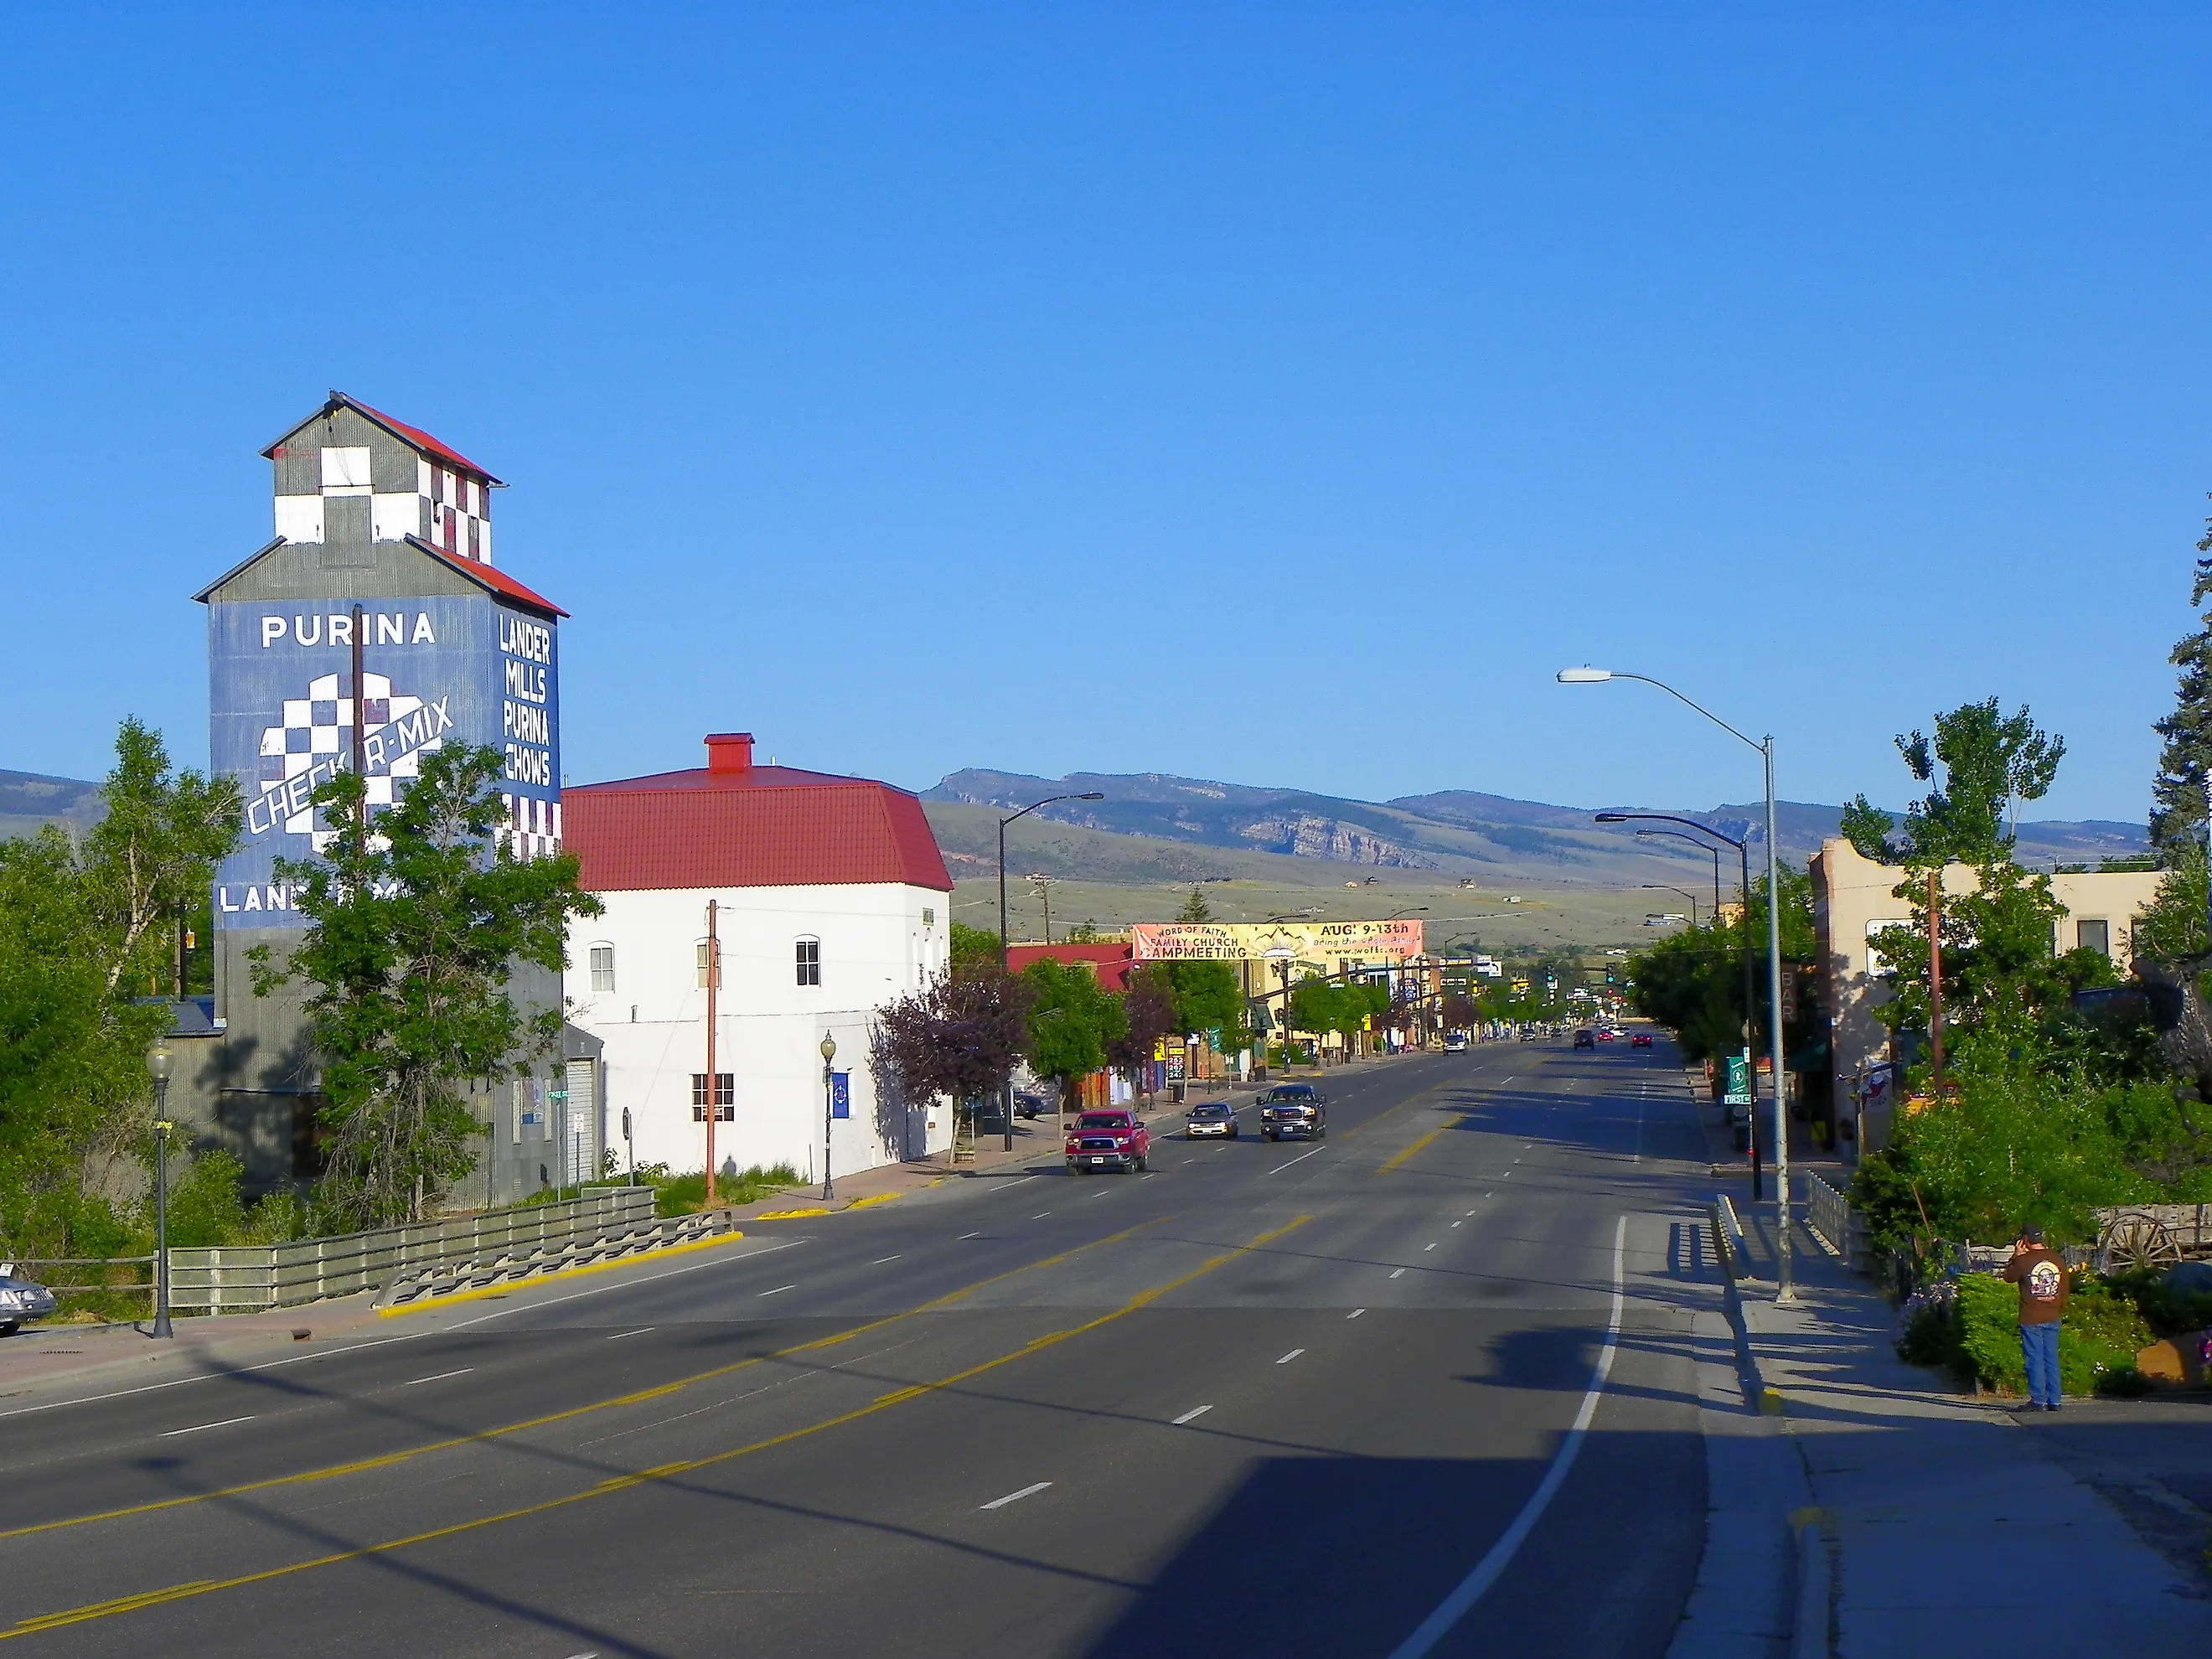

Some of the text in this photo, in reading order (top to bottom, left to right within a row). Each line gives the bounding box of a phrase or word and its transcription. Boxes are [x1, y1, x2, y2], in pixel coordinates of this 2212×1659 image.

[261, 612, 437, 649] PURINA
[499, 613, 551, 666] LANDER
[505, 658, 546, 705] MILLS
[504, 700, 550, 747] PURINA
[246, 695, 454, 836] CHECKR-MIX
[504, 742, 550, 788] CHOWS
[1150, 938, 1238, 947] FAMILY CHURCH
[1157, 927, 1182, 938] WORD
[1202, 926, 1227, 938] FAITH
[1313, 938, 1338, 947] Bring
[1363, 923, 1408, 934] 9-13th
[1145, 947, 1247, 959] CAMPMEETING
[1782, 972, 1793, 1020] BAR
